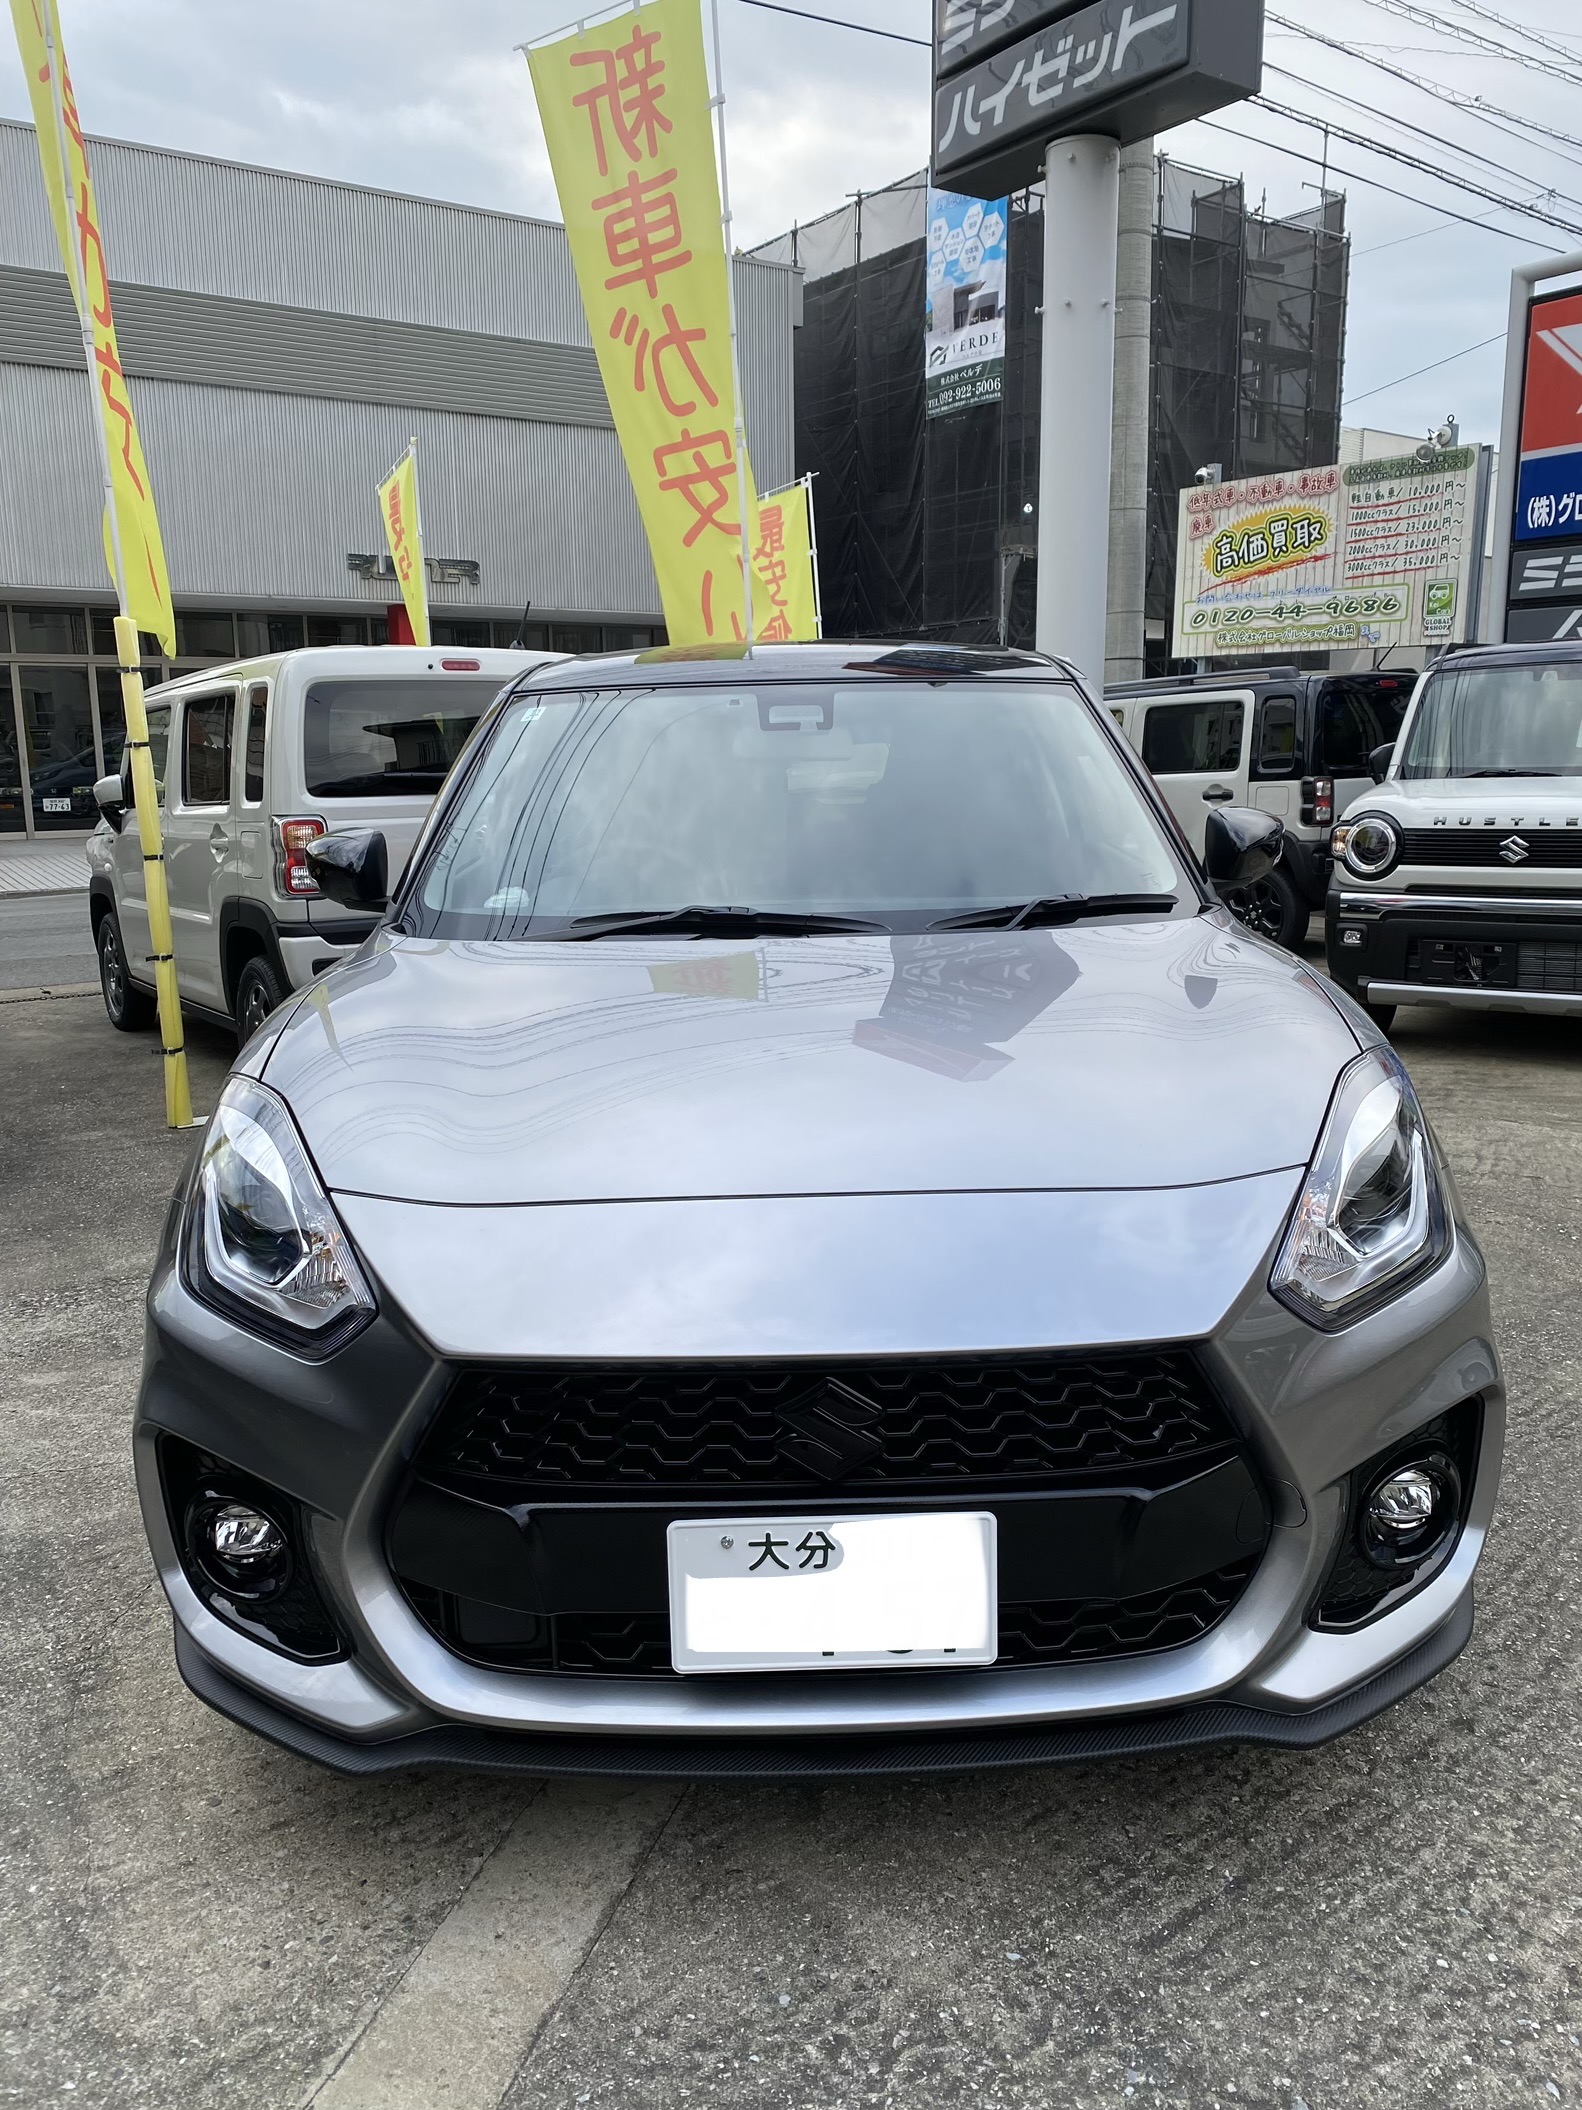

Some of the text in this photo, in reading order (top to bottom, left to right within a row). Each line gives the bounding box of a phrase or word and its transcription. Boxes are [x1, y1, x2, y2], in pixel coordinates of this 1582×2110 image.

[938, 4, 1178, 153] ハイゼット
[953, 332, 999, 354] VERDE
[939, 377, 1001, 405] 092-922-5006
[1192, 515, 1214, 535] 廃車
[1216, 519, 1323, 573] 高価買取
[1270, 586, 1331, 597] フリーダイヤル
[1193, 597, 1398, 625] 0120-44-9686
[1217, 623, 1355, 644] 株式会社グローバルショップ福岡
[1433, 816, 1580, 827] HUSTLE
[748, 1530, 837, 1571] 大分
